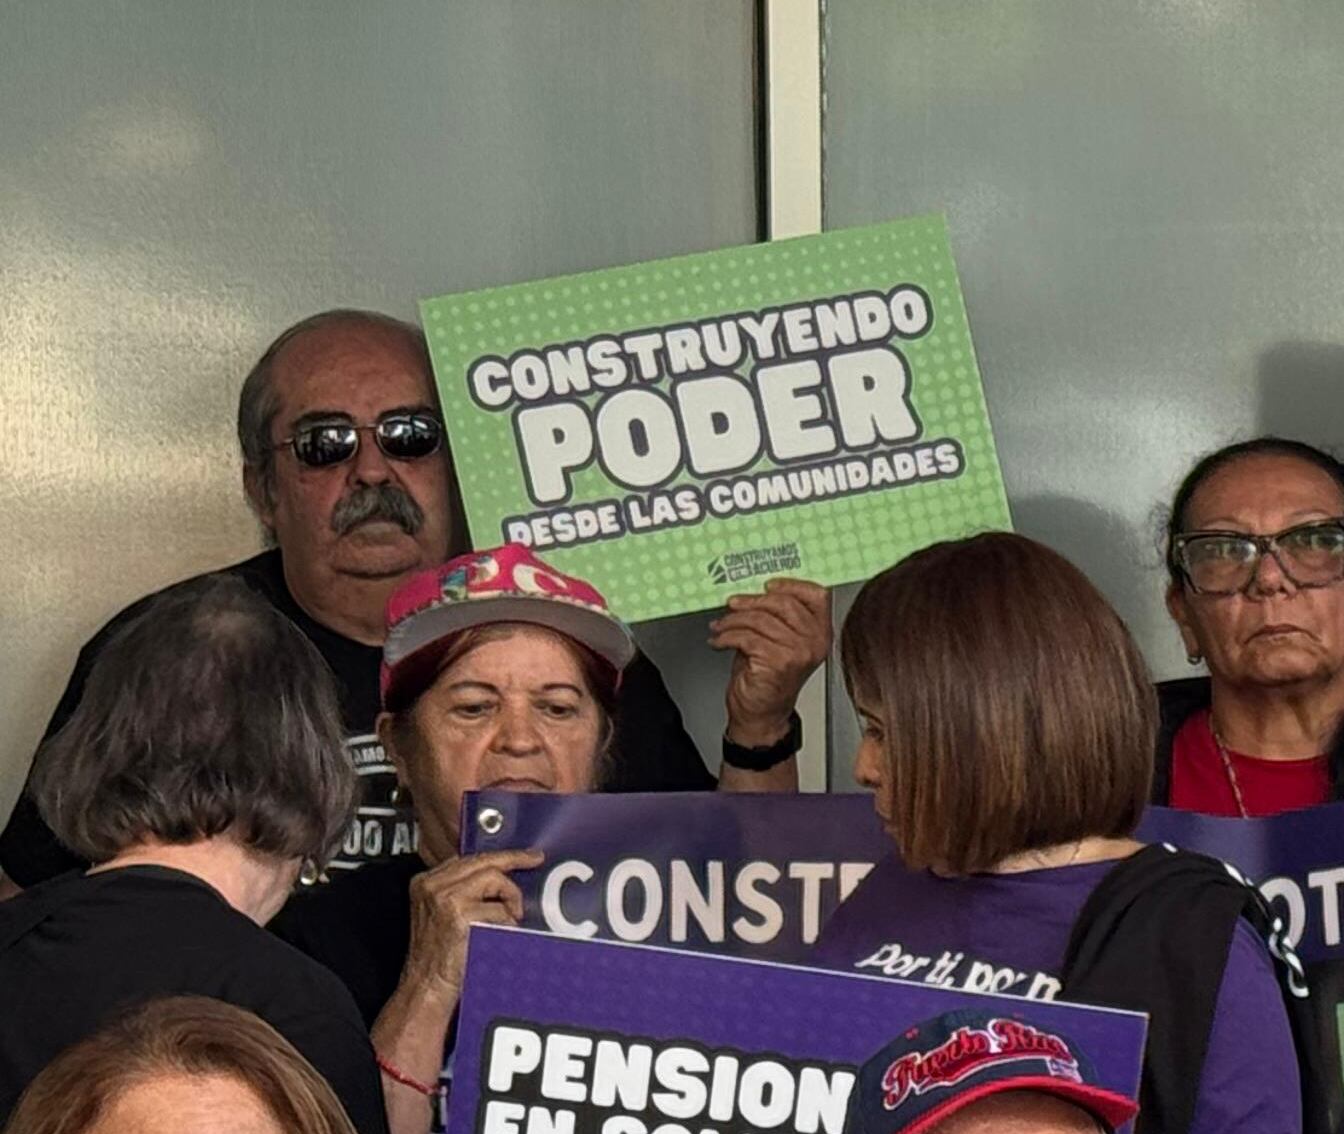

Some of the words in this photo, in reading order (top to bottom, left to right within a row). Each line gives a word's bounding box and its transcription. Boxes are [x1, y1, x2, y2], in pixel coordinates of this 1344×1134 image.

[472, 289, 929, 406] CONSTRUYENDO
[518, 347, 918, 502] PODER
[508, 503, 619, 548] DESDE
[630, 489, 700, 527] LAS
[709, 443, 960, 514] COMUNIDADES
[854, 943, 931, 977] Por
[882, 1027, 990, 1110] Puerto
